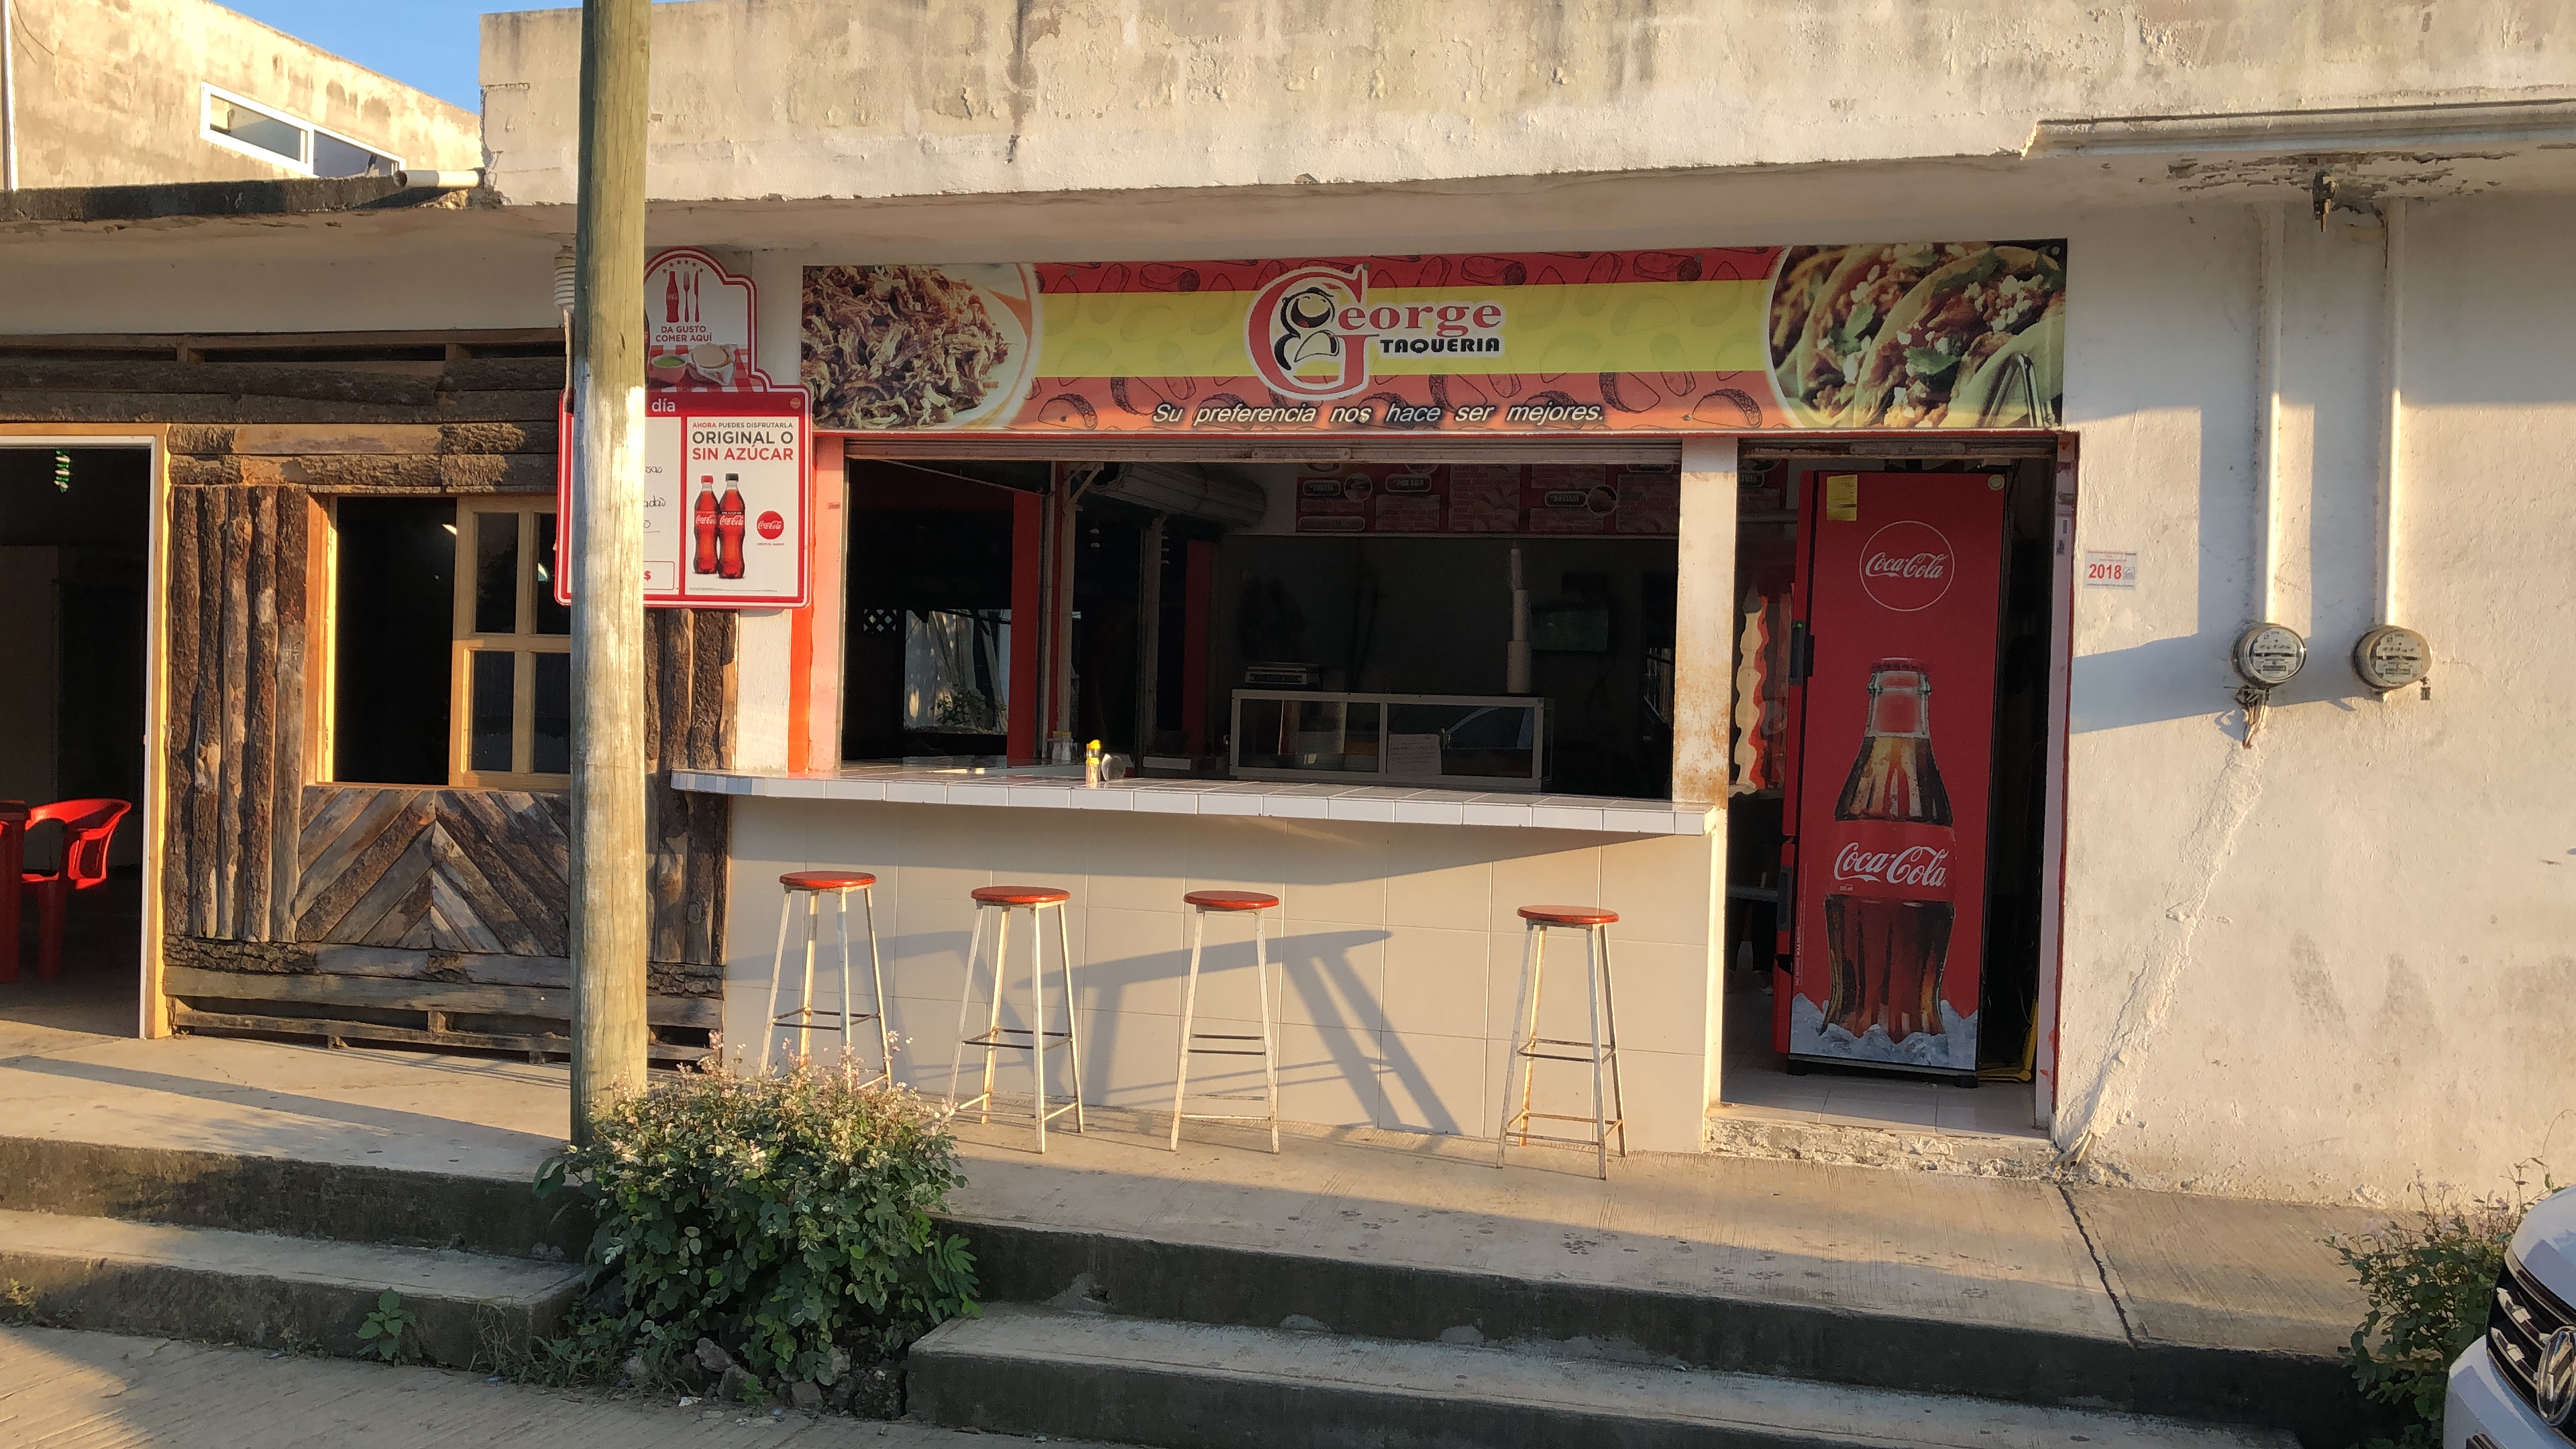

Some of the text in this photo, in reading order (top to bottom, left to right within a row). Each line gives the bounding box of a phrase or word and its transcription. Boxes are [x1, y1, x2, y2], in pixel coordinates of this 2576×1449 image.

[655, 332, 712, 342] COMER AQUÍ
[661, 325, 706, 333] DA GUSTO
[1248, 264, 1501, 396] George
[1379, 337, 1501, 354] TAQUERIA
[651, 398, 676, 413] día
[1152, 402, 1604, 427] Su preferencia nos hace ser mejores.
[692, 431, 794, 445] ORIGINAL O
[692, 444, 794, 461] SIN AZÚCAR
[1865, 551, 1949, 579] Coca-Cola
[2088, 564, 2122, 580] 2018
[644, 570, 651, 581] $
[1833, 842, 1949, 887] Coca-Cola
